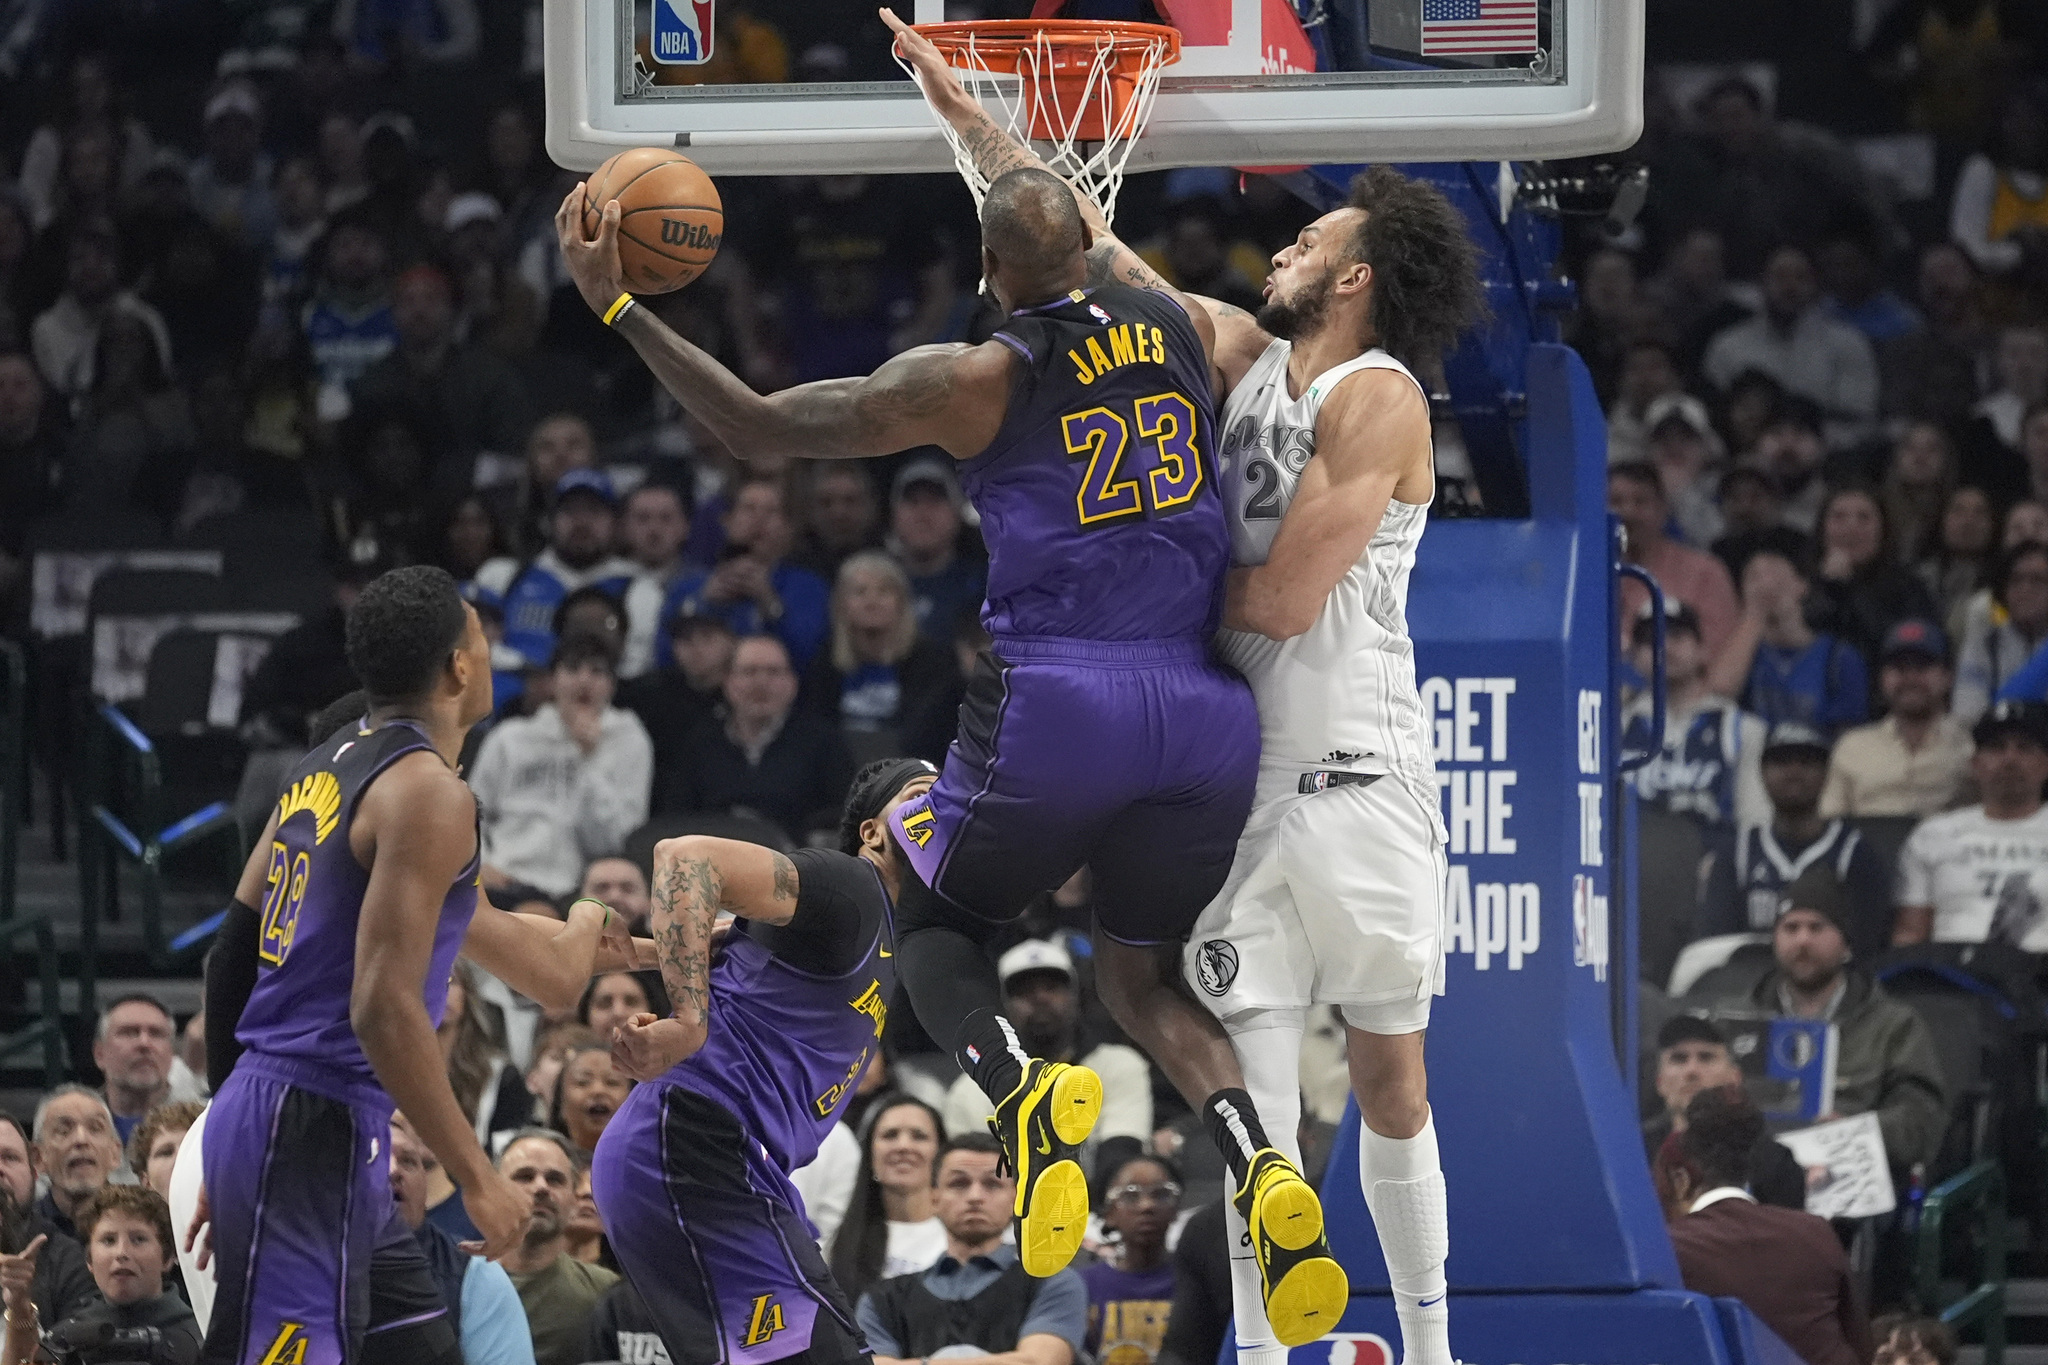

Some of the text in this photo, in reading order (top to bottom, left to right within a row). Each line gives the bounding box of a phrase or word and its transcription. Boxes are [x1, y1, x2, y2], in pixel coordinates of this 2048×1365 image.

[661, 31, 690, 54] NBA
[661, 217, 721, 250] Wilso
[1067, 323, 1166, 386] JAMES
[1060, 391, 1204, 525] 23
[1242, 457, 1282, 522] 2
[1419, 676, 1517, 762] GET
[1577, 688, 1602, 775] GET
[901, 805, 937, 851] LA
[1577, 782, 1604, 867] THE
[259, 841, 310, 967] 28
[1444, 864, 1541, 971] App
[1586, 875, 1609, 983] App
[740, 1293, 787, 1349] LA
